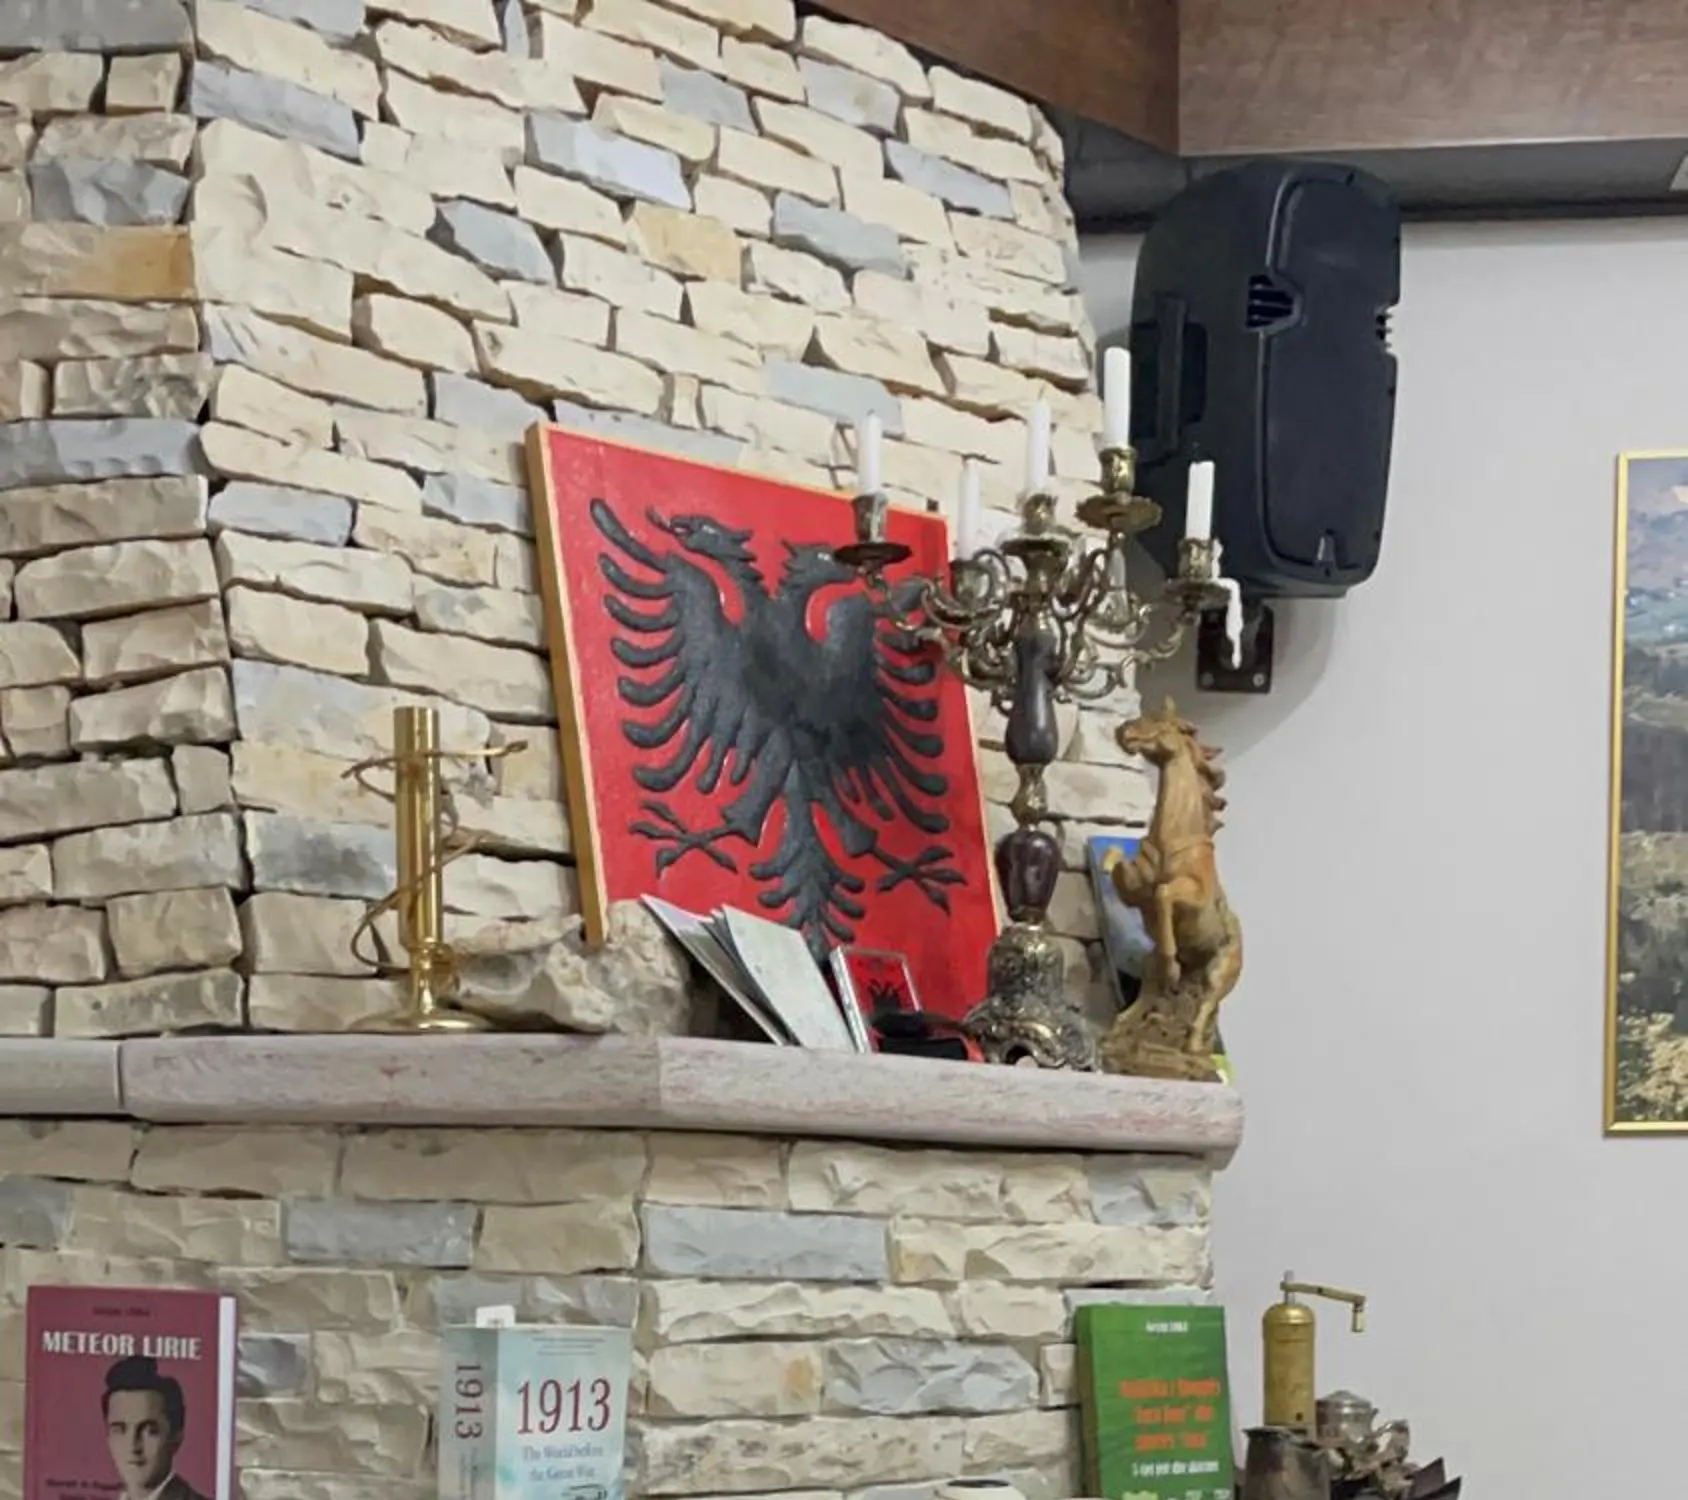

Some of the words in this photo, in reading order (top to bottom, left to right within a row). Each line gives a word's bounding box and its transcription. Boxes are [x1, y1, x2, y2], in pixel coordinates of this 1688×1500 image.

[42, 1331, 135, 1357] METEOR
[142, 1335, 202, 1360] LIRIE
[454, 1363, 484, 1440] 1913
[516, 1377, 612, 1435] 1913
